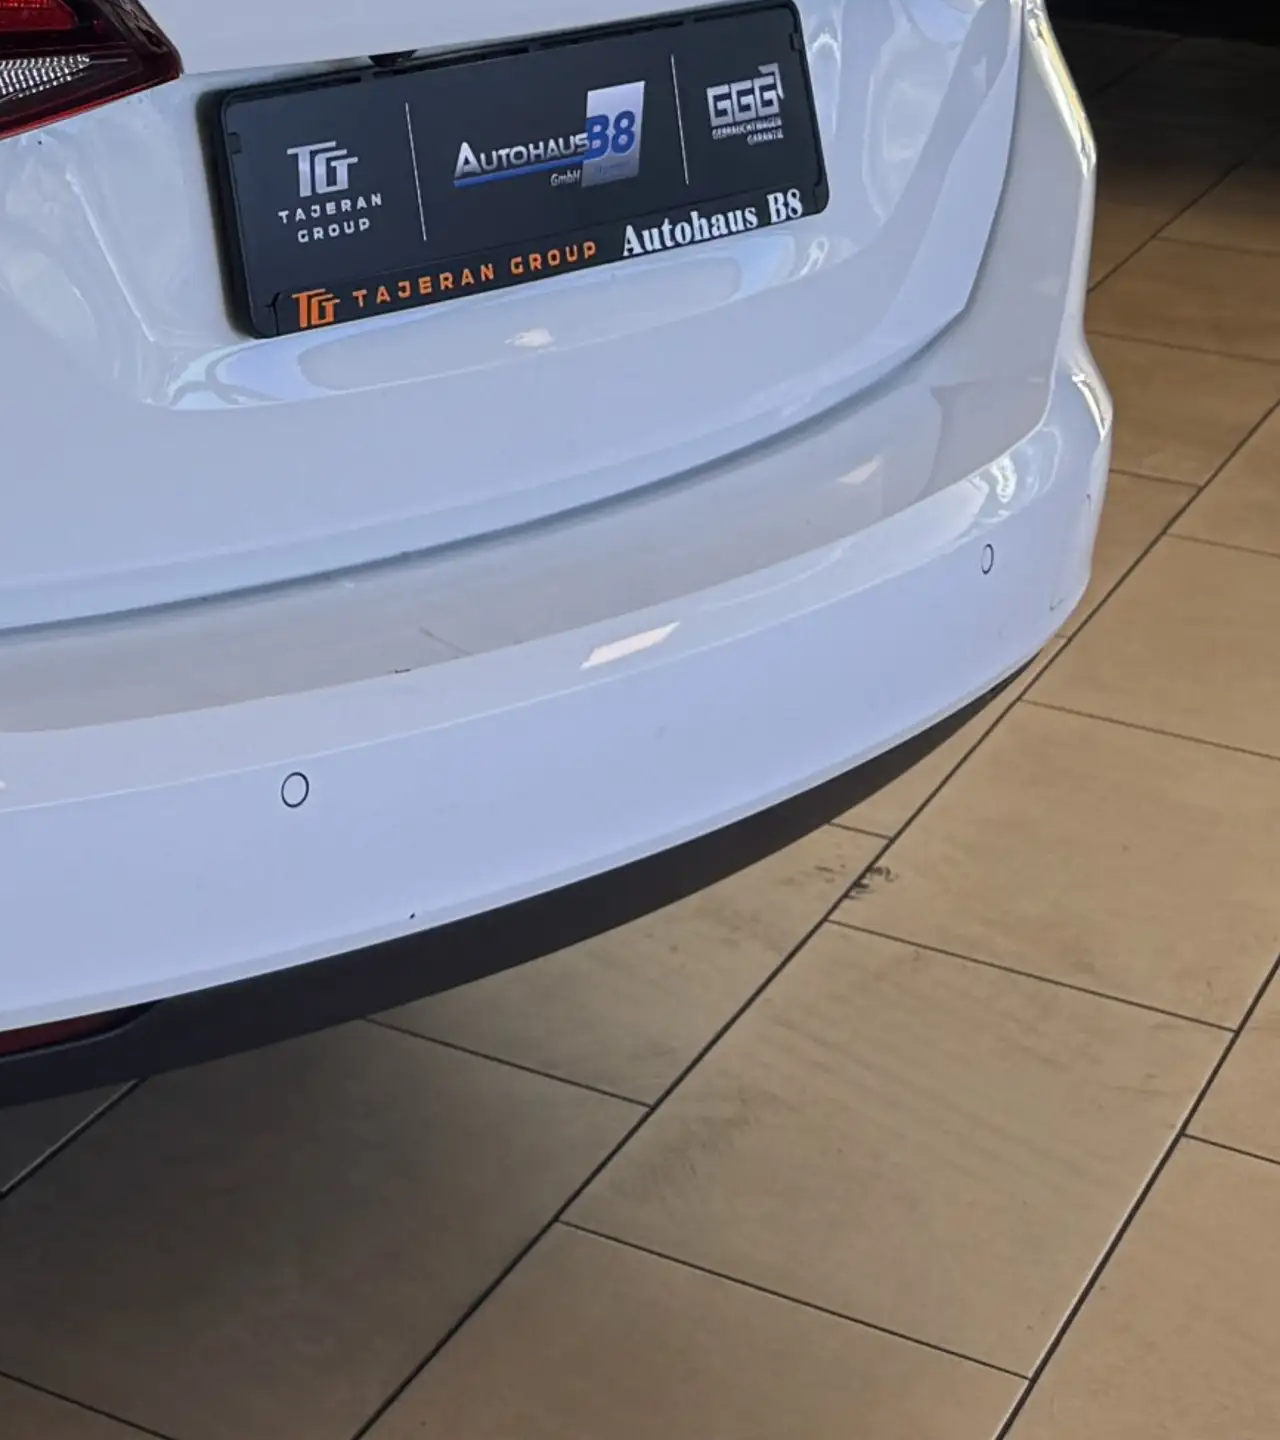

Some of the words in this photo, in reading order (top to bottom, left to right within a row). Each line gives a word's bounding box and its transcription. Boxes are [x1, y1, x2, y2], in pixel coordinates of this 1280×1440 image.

[706, 68, 783, 127] GGG
[454, 131, 589, 179] AUTOHAUS
[584, 109, 636, 161] B8
[550, 168, 581, 187] GmbH
[277, 193, 382, 224] TAJERAN
[297, 218, 370, 243] GROUP
[622, 206, 759, 257] Autohaus
[766, 188, 804, 224] B8
[352, 263, 495, 308] TAJERAN
[509, 241, 597, 275] GROUP
